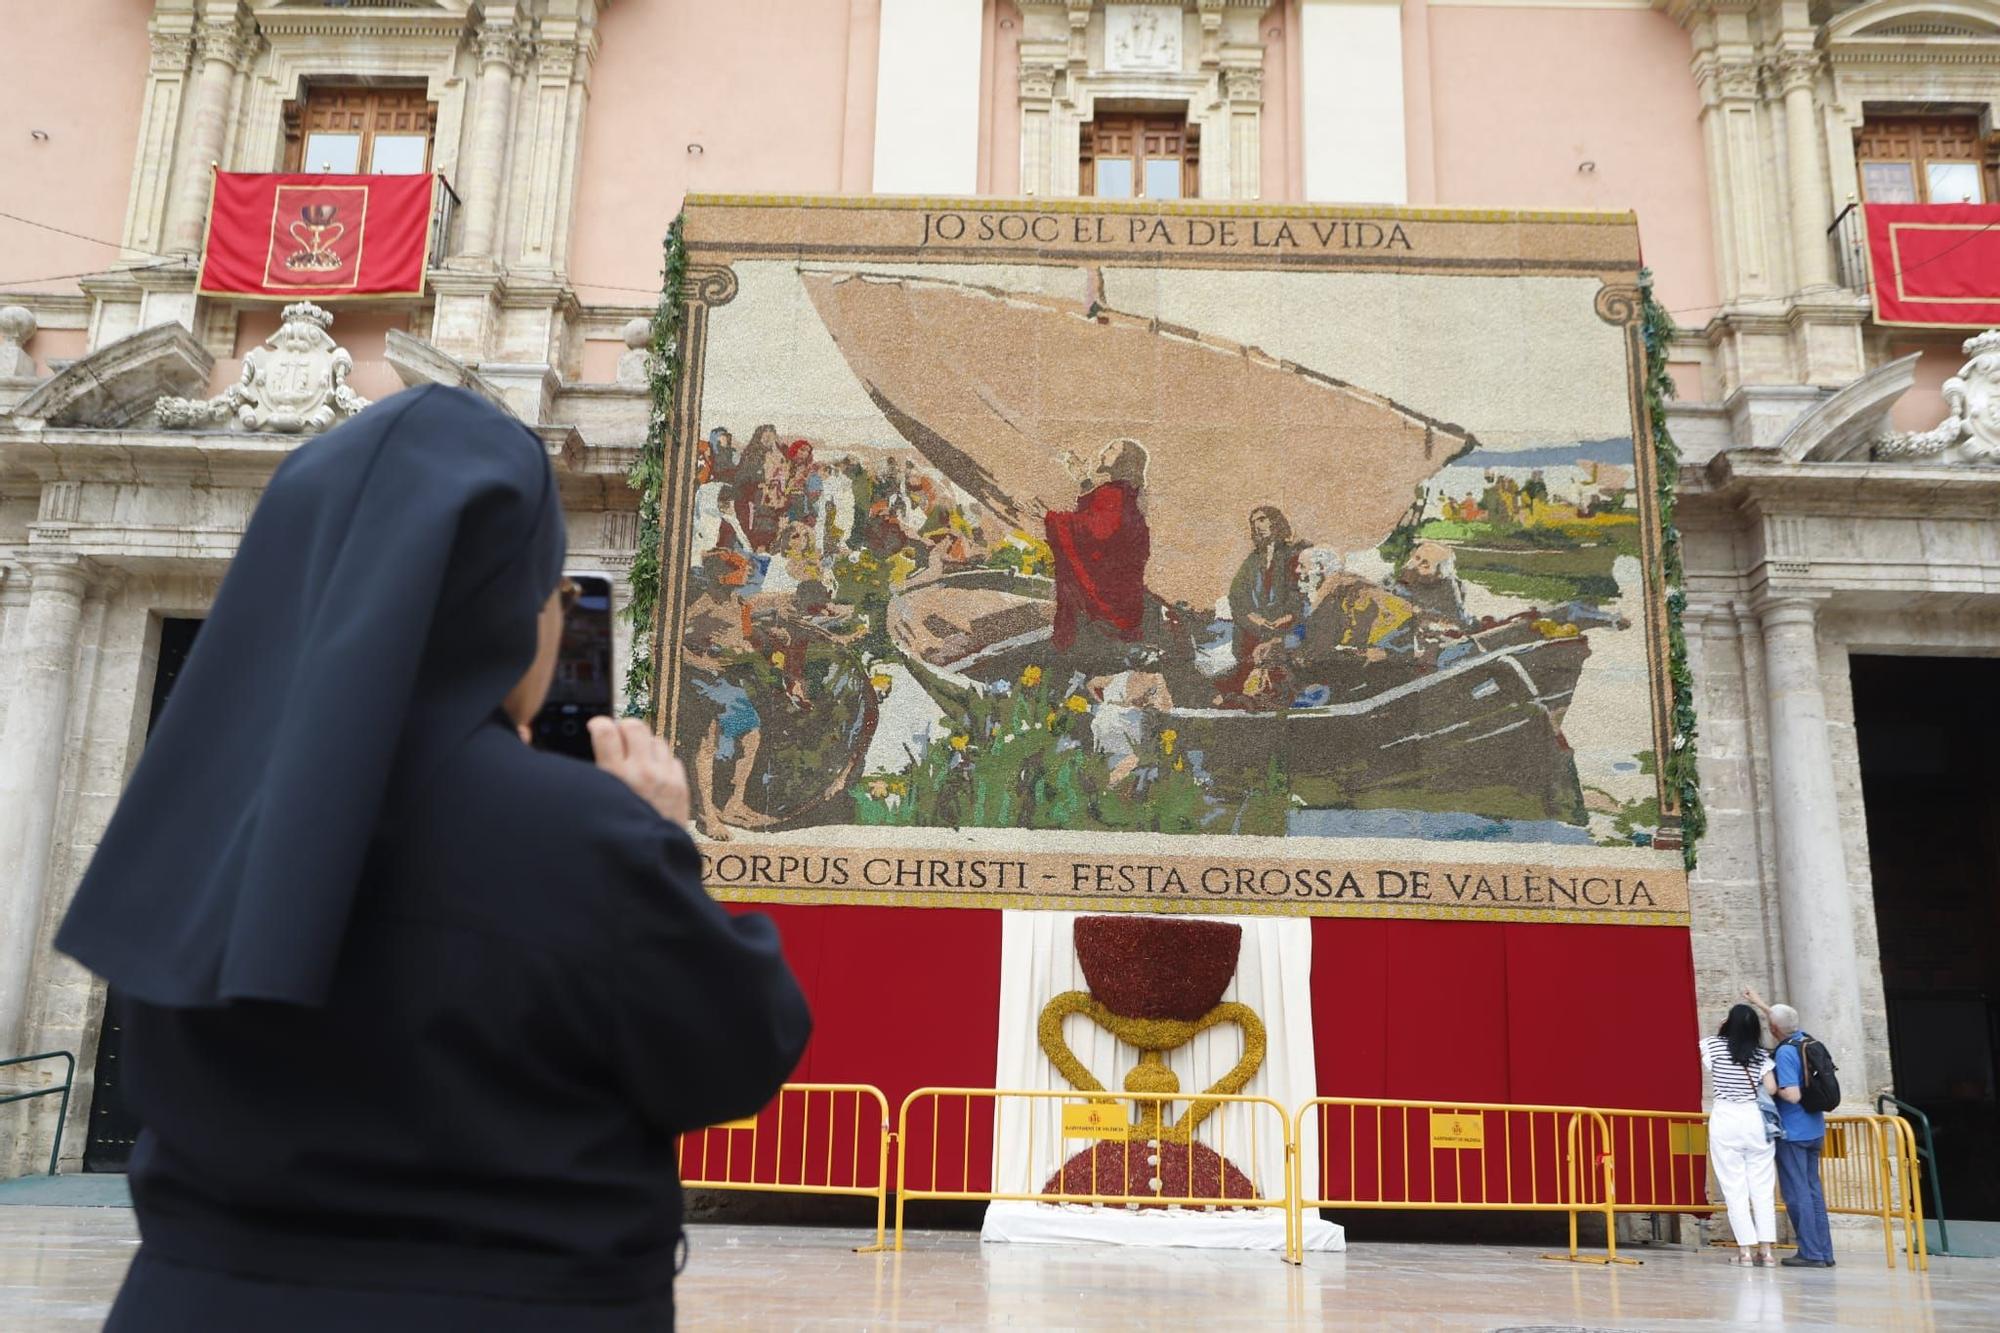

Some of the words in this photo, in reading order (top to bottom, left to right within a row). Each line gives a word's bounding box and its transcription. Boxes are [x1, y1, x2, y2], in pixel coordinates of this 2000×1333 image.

[921, 213, 966, 245] JO
[978, 214, 1060, 242] SOC
[1073, 217, 1114, 243] EL
[1129, 217, 1177, 245] PA
[1187, 219, 1237, 247] DE
[1253, 220, 1300, 248] LA
[1310, 222, 1413, 250] VIDA
[863, 858, 1028, 891] CHRISTI
[1072, 863, 1188, 894] FESTA
[1200, 866, 1366, 898] GROSSA
[1375, 870, 1433, 899] DE
[1443, 869, 1658, 906] VALÈNCIA
